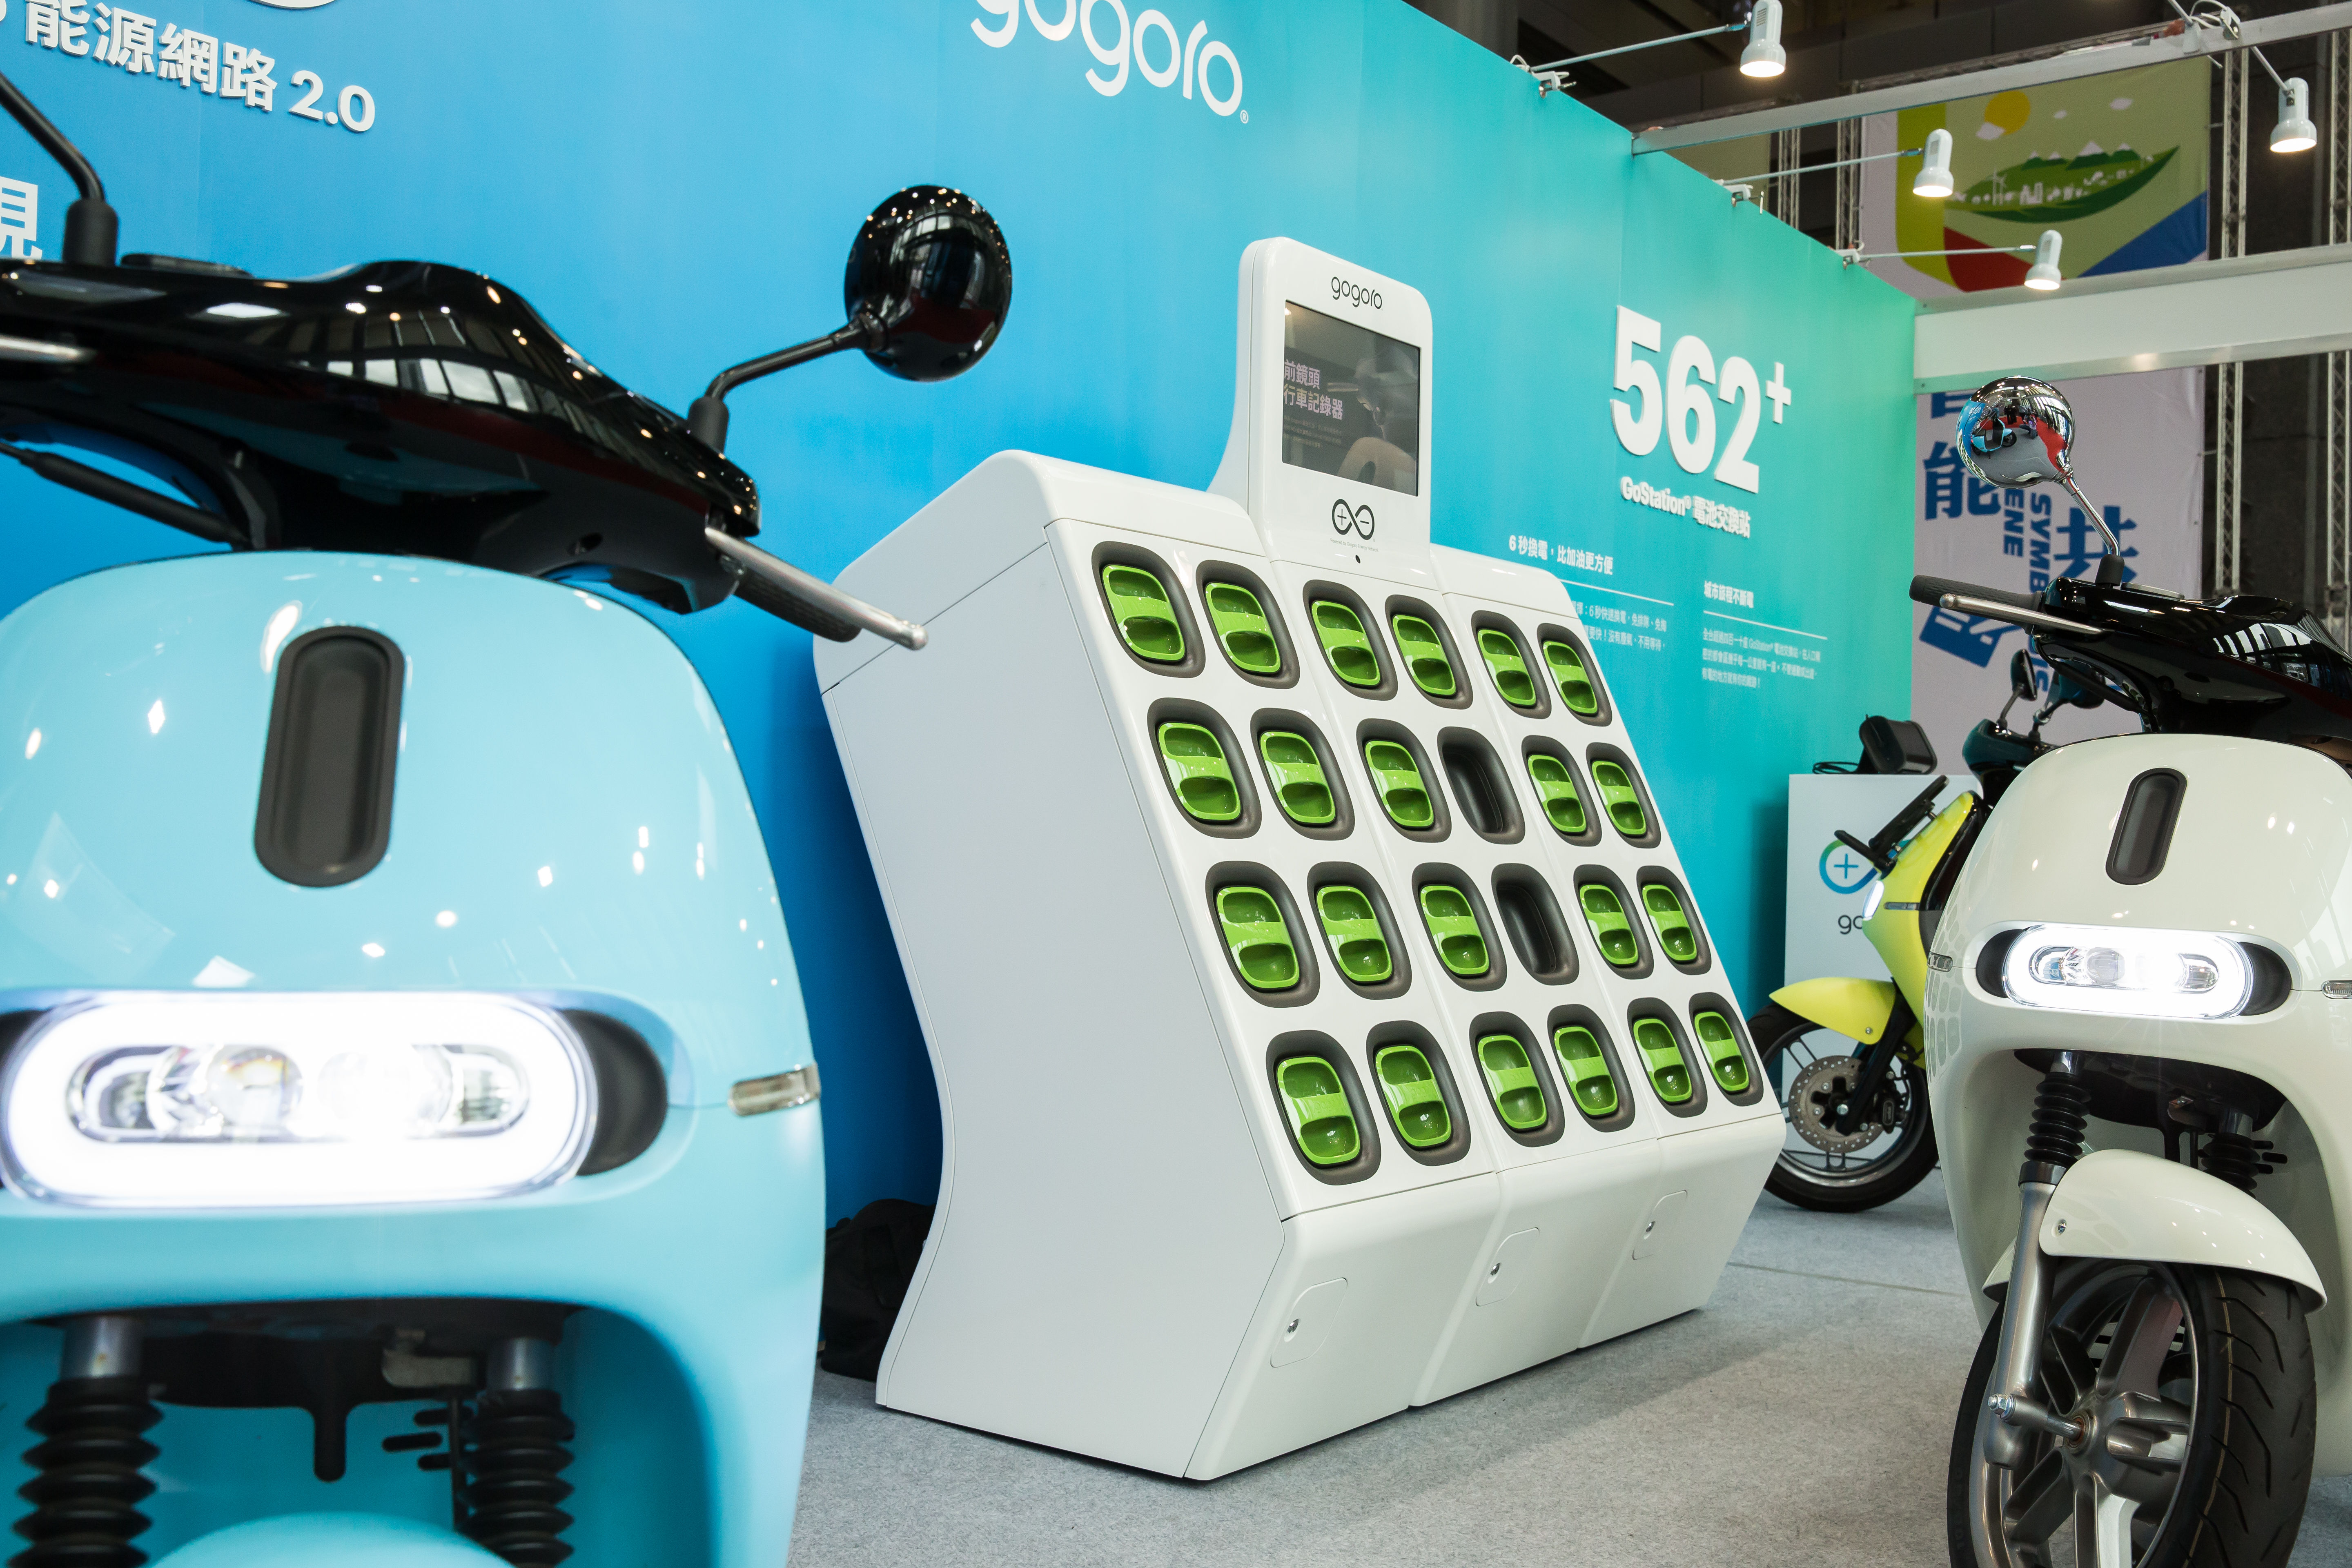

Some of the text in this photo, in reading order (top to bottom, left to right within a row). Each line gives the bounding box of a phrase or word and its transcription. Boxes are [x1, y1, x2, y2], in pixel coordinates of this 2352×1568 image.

[25, 0, 375, 132] 能源網路 2.0
[1331, 276, 1382, 310] gogoro
[1284, 359, 1320, 390] 前鏡頭
[1284, 383, 1343, 420] 行車記錄器
